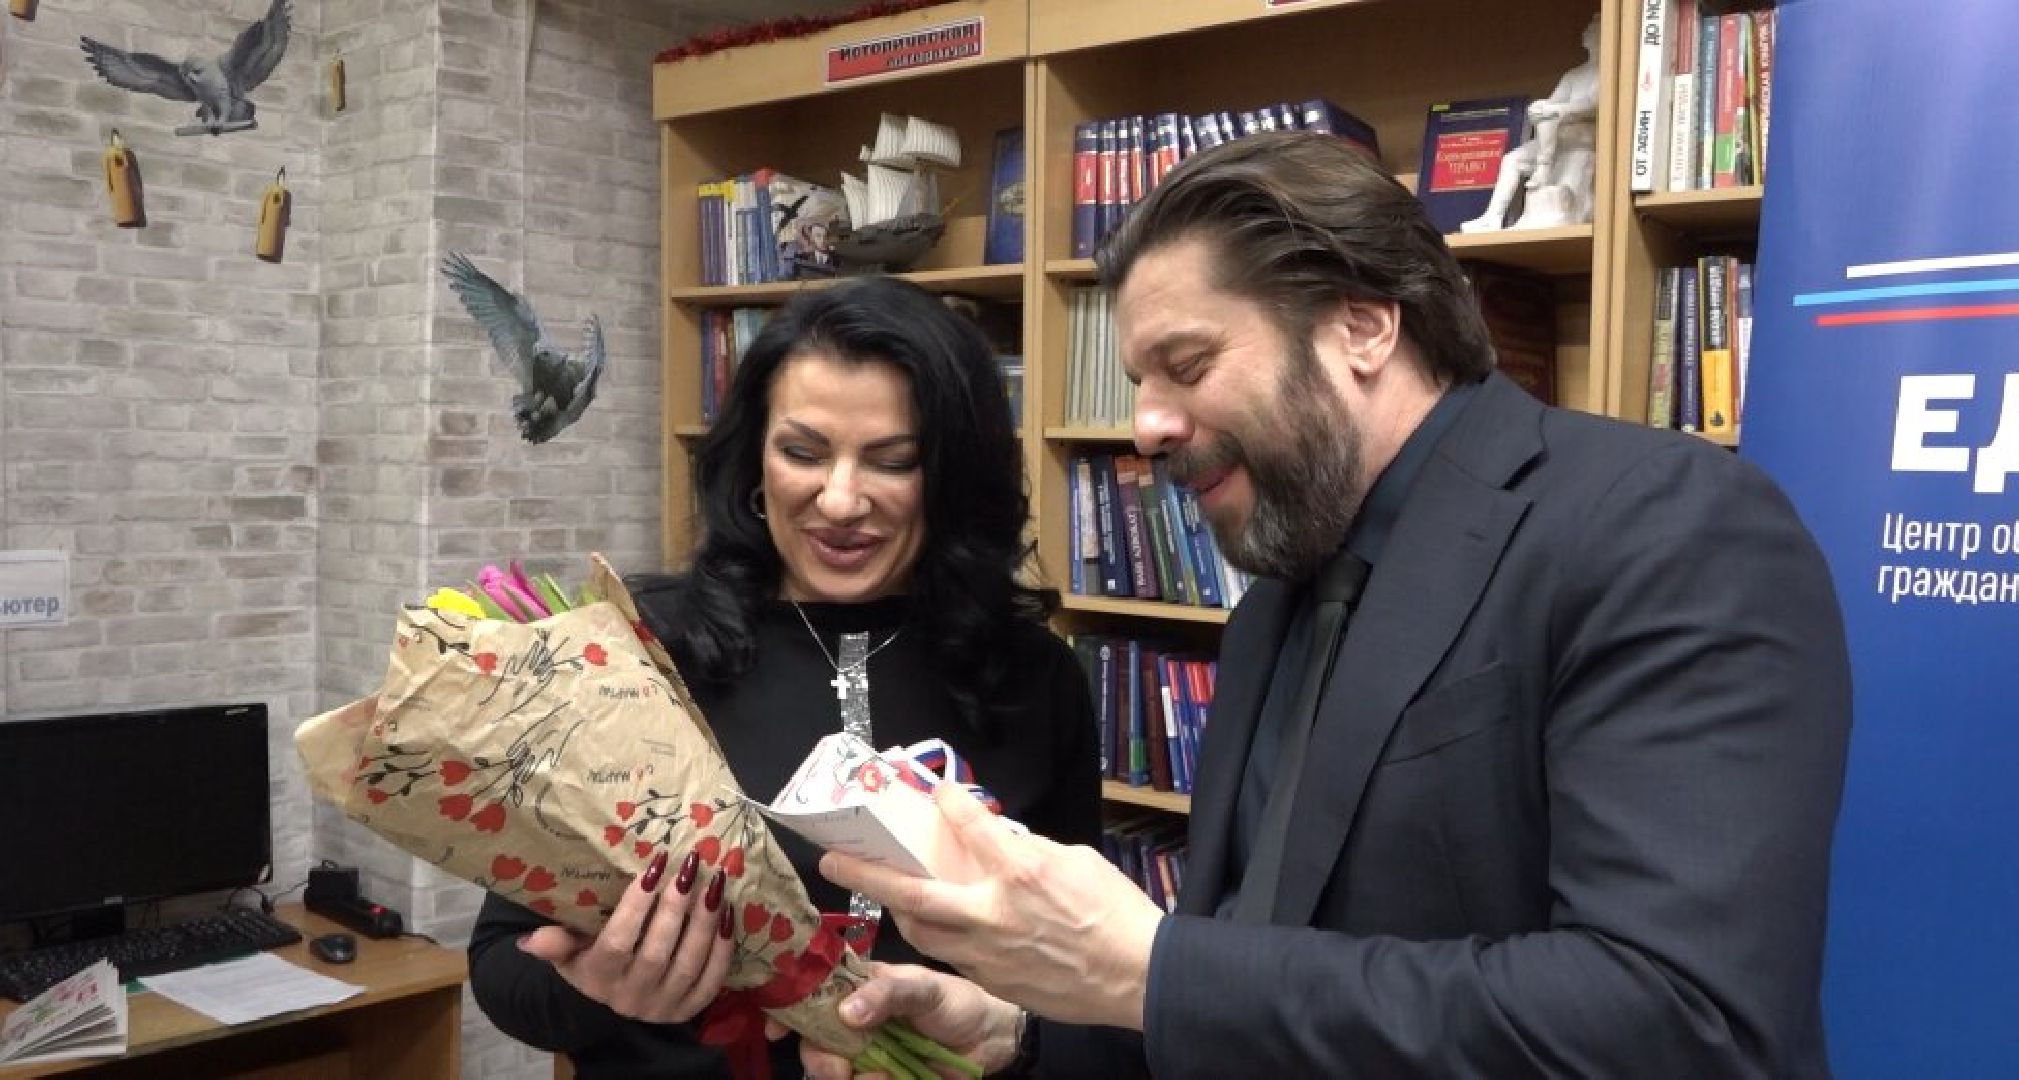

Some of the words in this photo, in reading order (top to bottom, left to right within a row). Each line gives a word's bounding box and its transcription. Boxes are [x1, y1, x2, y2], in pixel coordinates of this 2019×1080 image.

[1882, 512, 1981, 560] Центр
[1877, 565, 2019, 605] граждан
[0, 596, 60, 617] ютер
